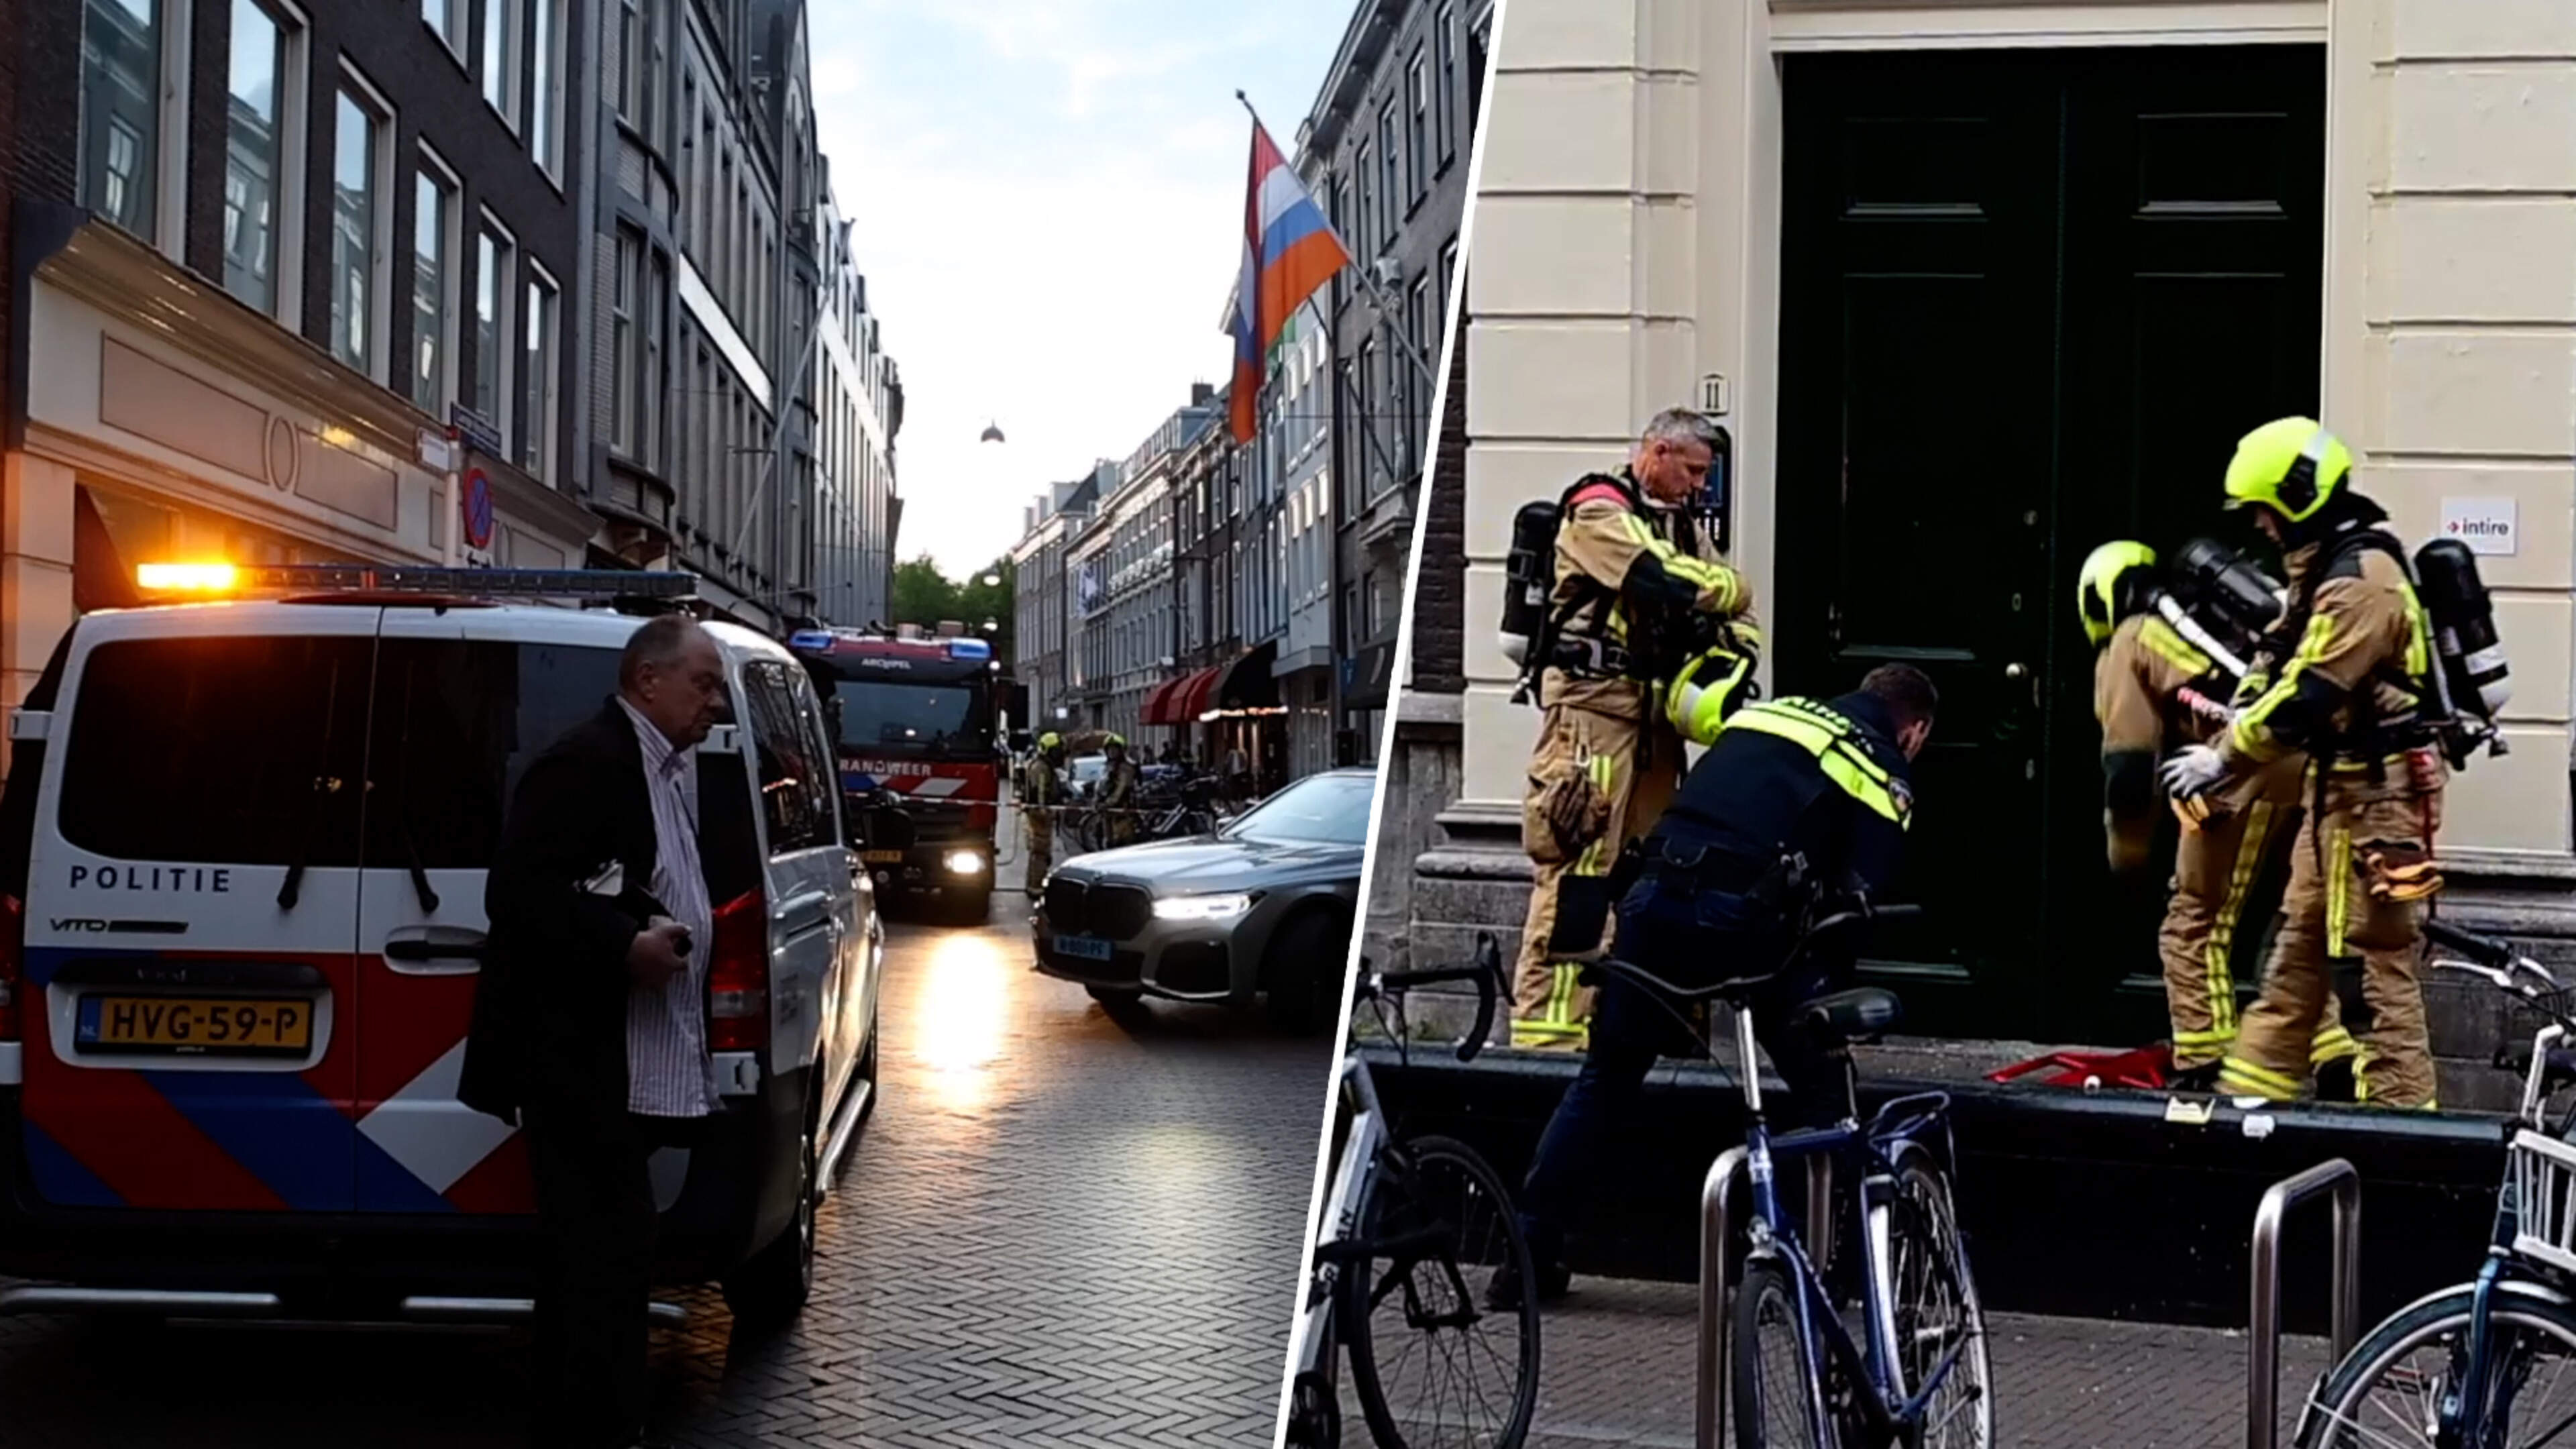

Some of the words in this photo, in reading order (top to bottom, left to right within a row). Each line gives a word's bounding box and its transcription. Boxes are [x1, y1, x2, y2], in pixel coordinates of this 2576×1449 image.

[2462, 517, 2509, 535] intire
[839, 758, 932, 777] RANDWEER
[70, 865, 229, 892] POLITIE
[50, 917, 107, 932] VITO
[111, 1004, 298, 1042] HVG-59-P
